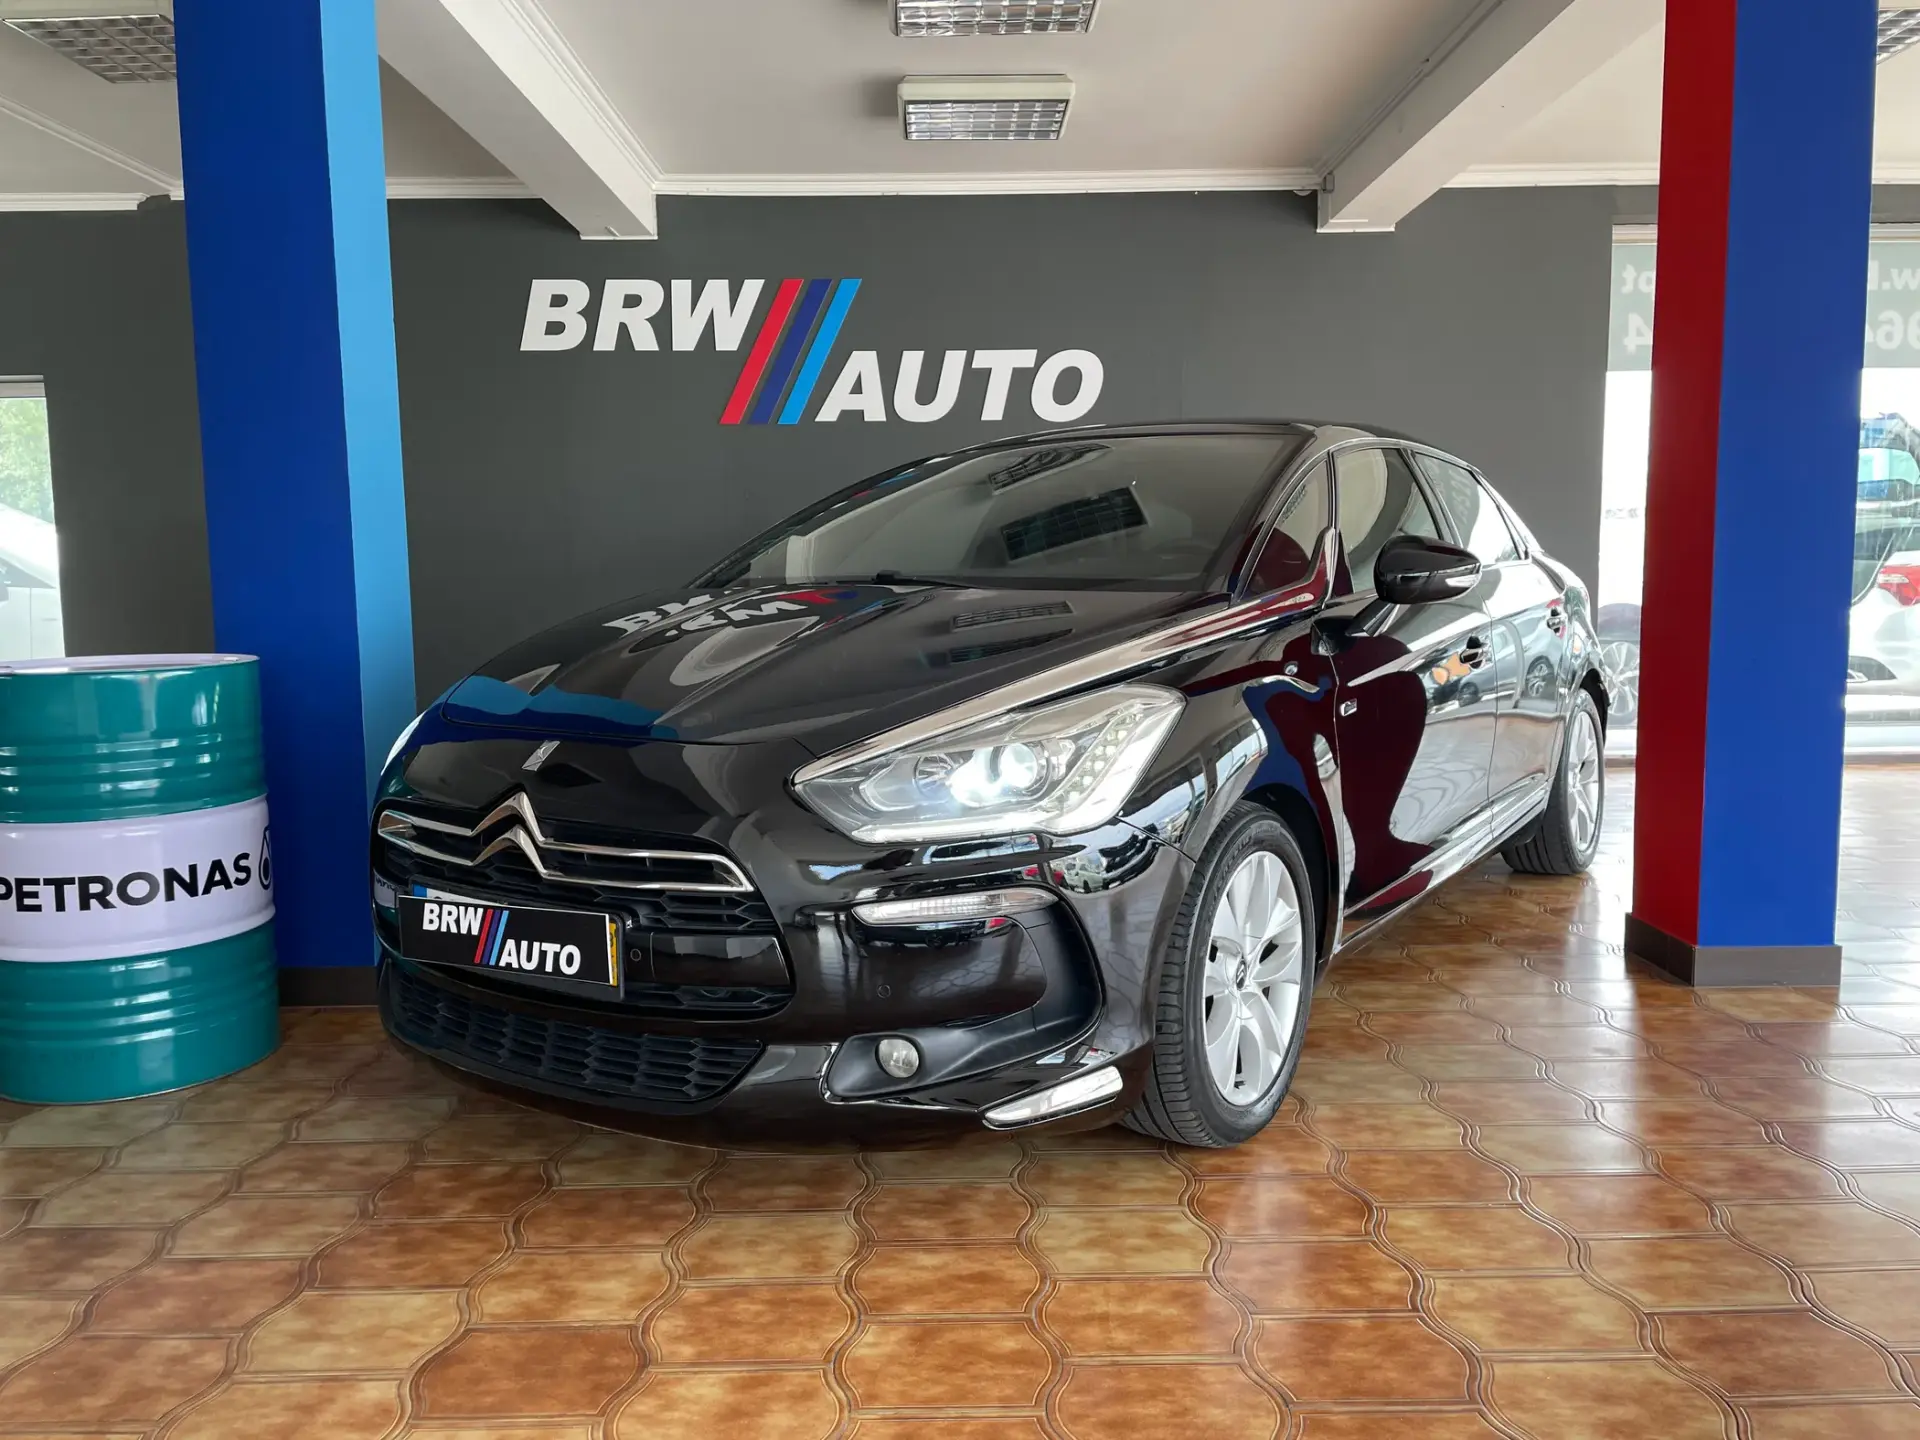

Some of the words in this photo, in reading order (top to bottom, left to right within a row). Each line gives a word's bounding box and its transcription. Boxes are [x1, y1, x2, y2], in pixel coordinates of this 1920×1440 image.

[519, 279, 765, 351] BRW
[814, 349, 1104, 423] AUTO
[422, 902, 484, 936] BRW
[499, 938, 582, 975] AUTO
